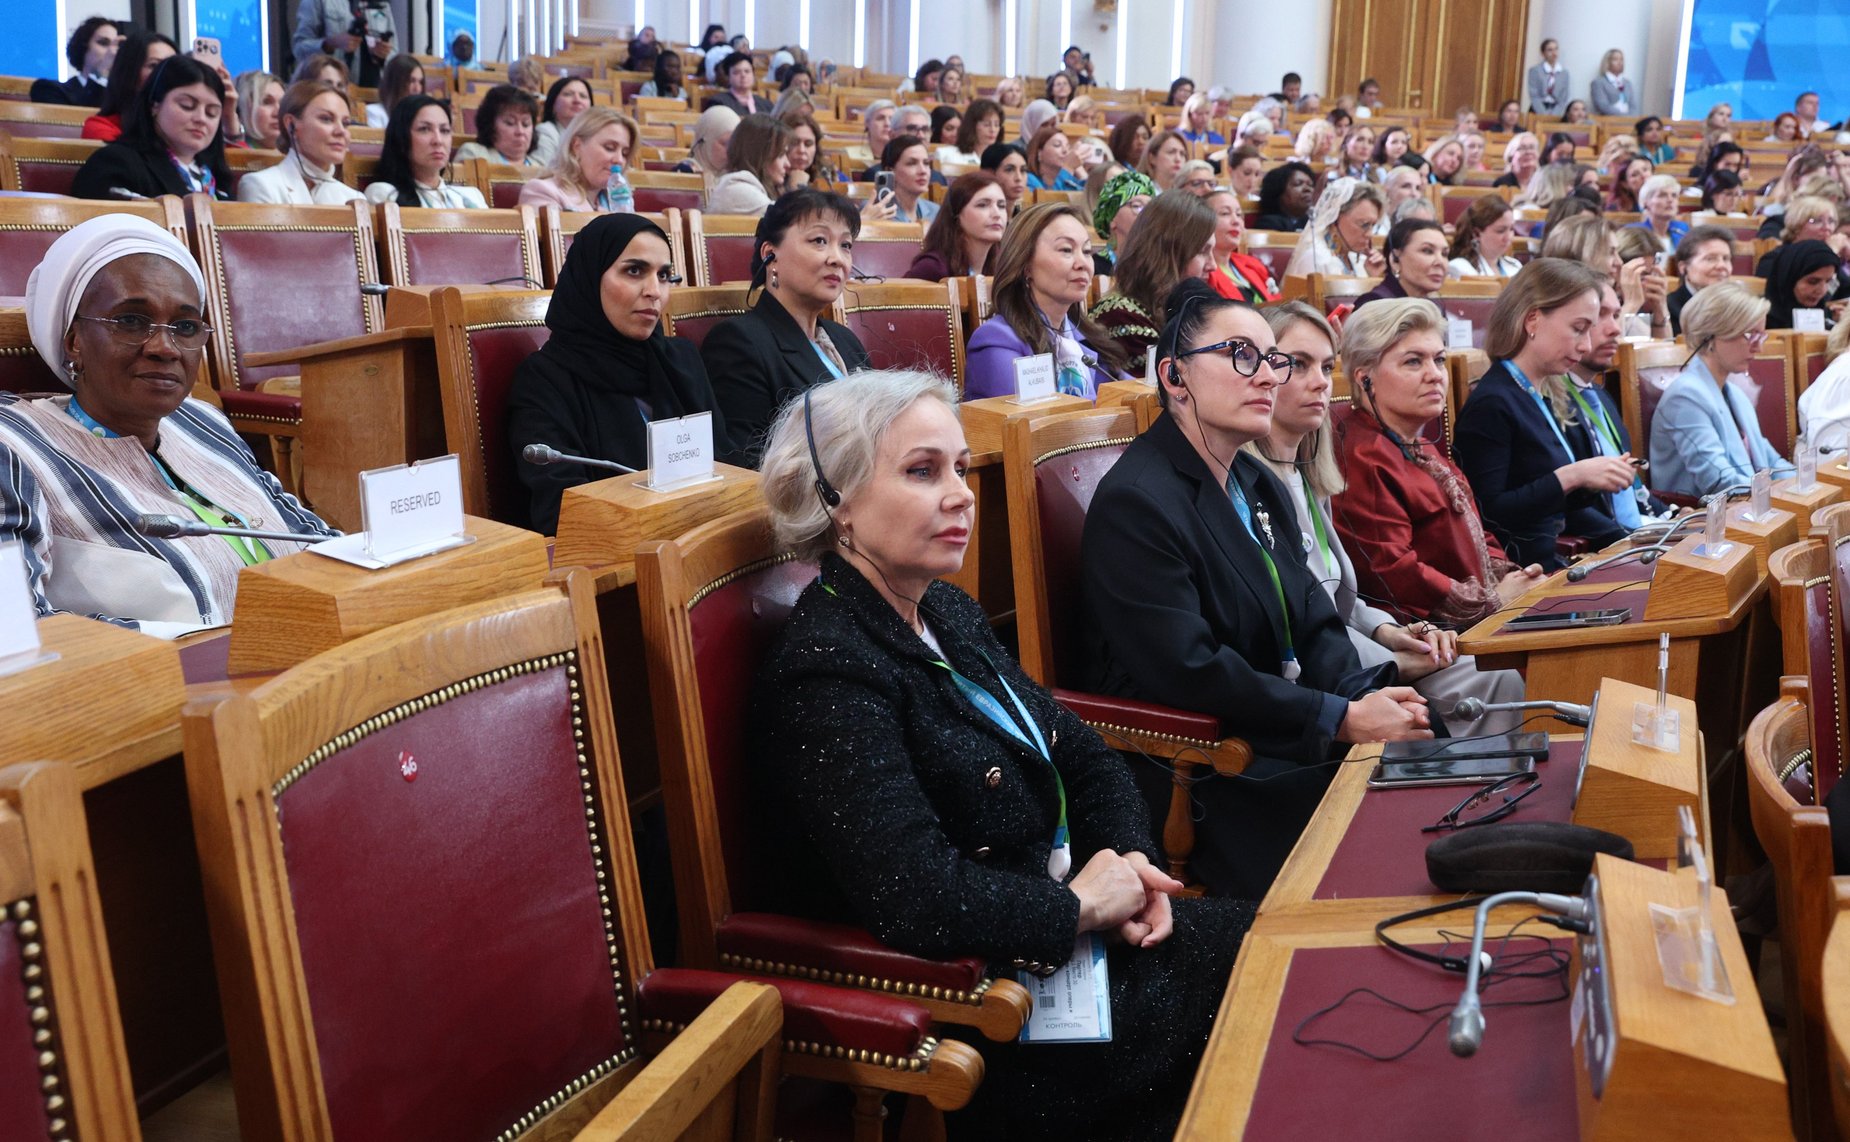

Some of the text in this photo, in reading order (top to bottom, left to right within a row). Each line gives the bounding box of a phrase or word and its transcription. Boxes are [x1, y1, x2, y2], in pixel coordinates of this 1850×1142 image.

[676, 433, 691, 445] OLGA
[668, 447, 701, 463] SOBCHENKO
[390, 490, 441, 515] RESERVED
